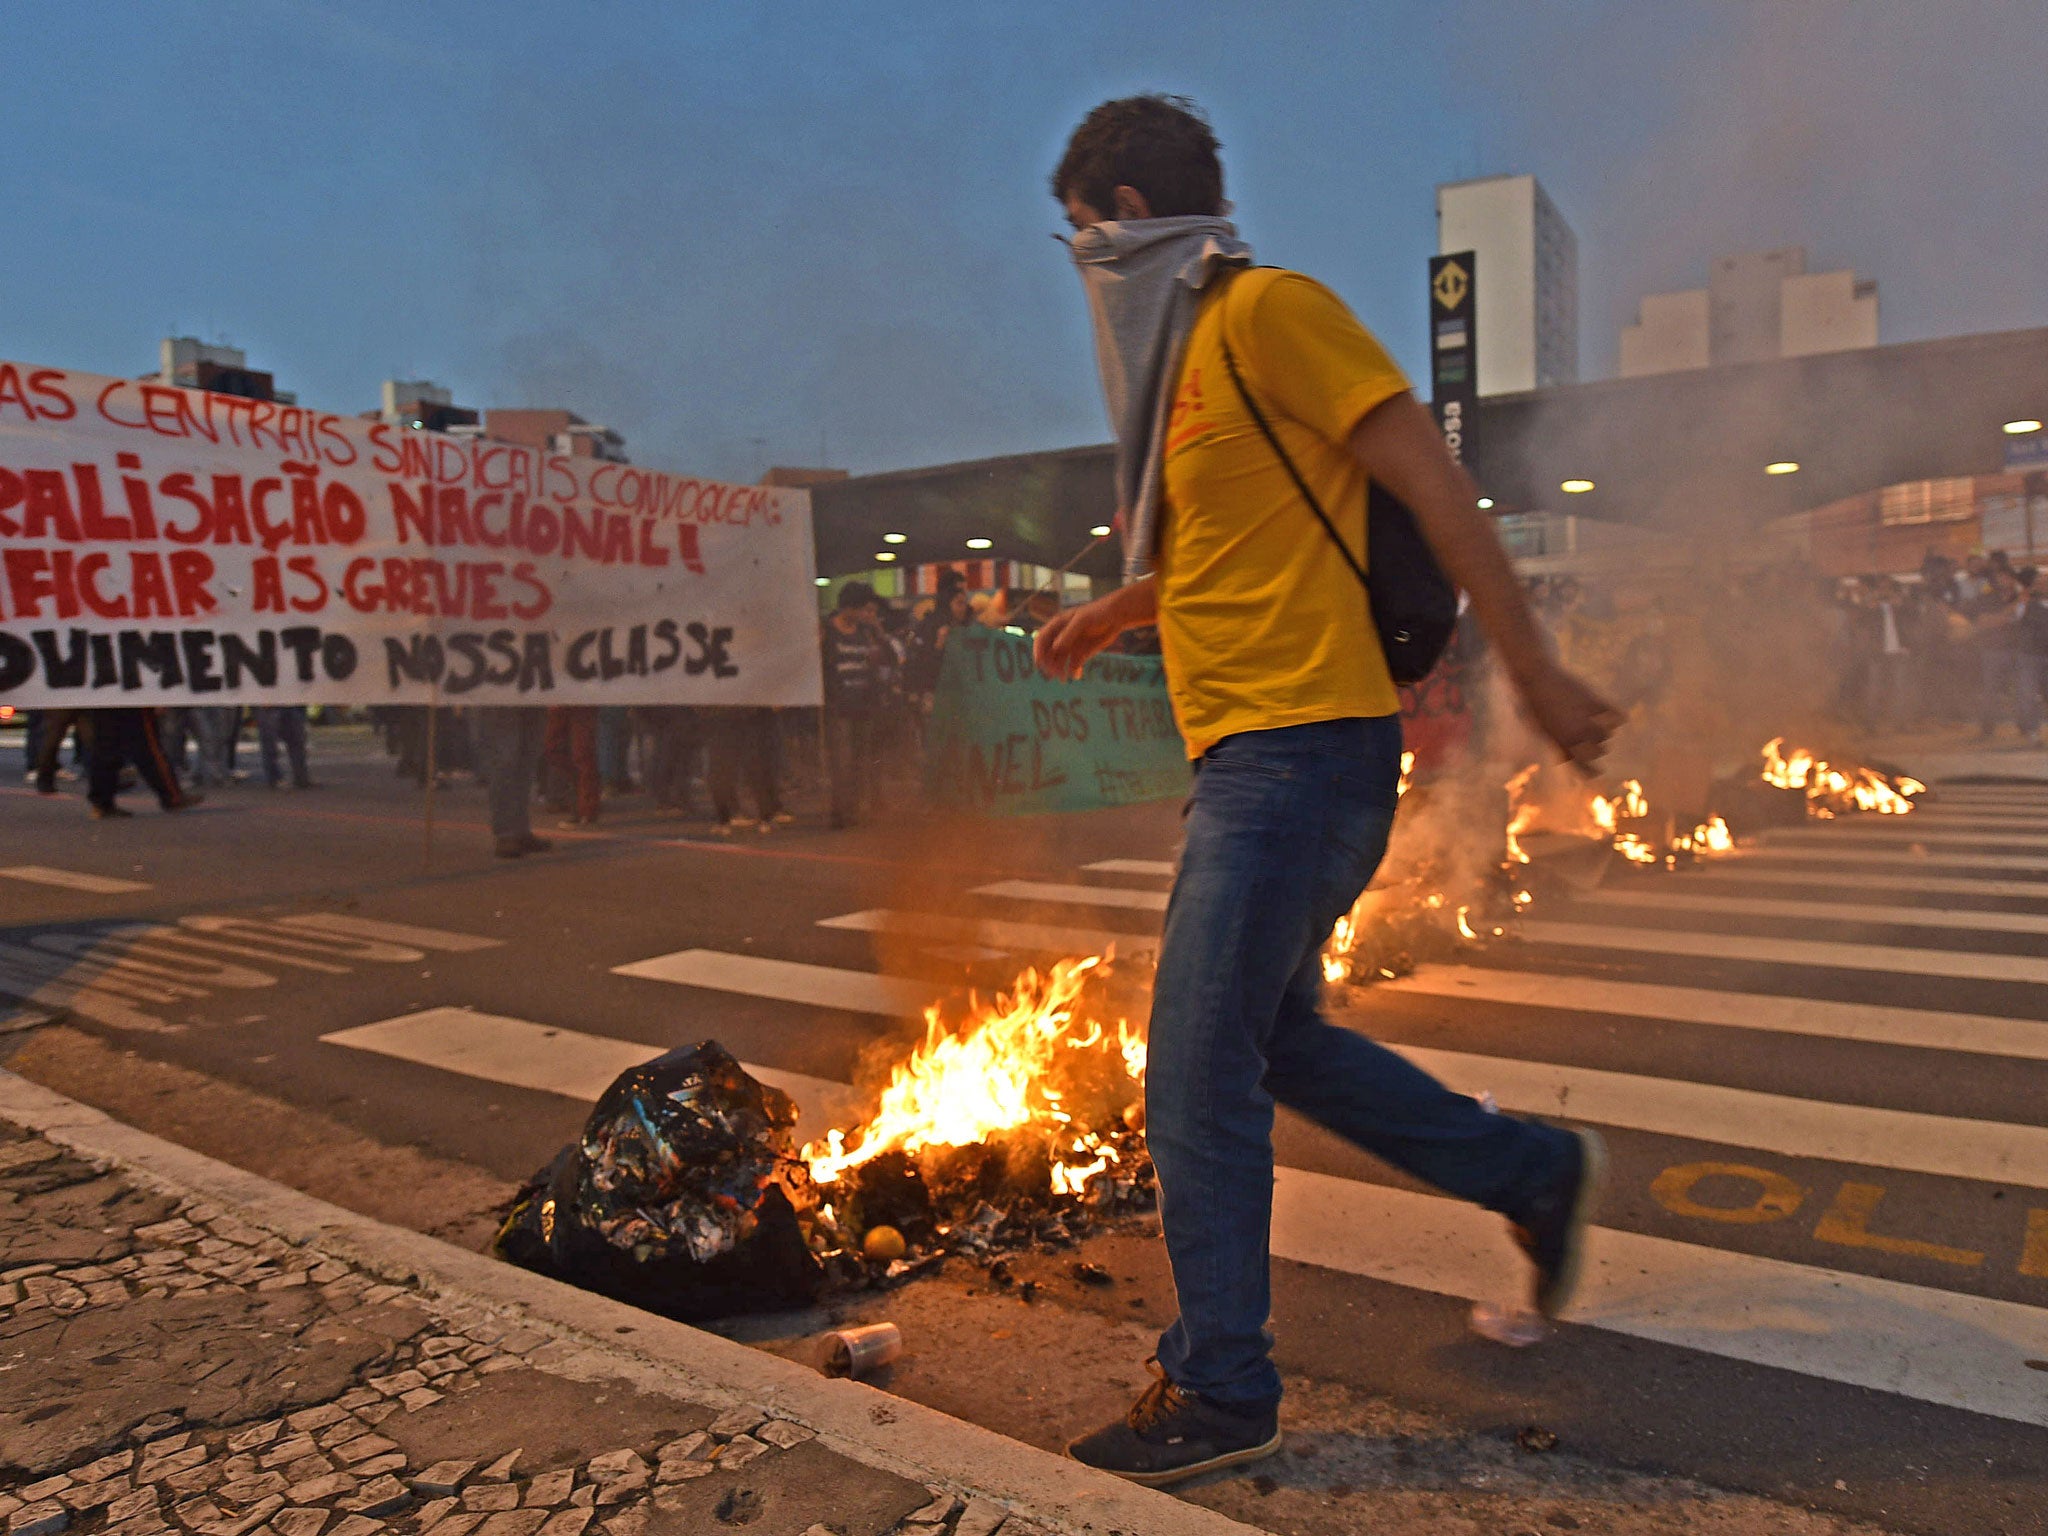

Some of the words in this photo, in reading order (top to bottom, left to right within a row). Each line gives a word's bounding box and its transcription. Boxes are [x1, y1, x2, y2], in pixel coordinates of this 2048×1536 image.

[97, 381, 358, 466] CENTRAIS
[0, 548, 218, 623] FICAR
[343, 556, 552, 622] GREVES
[383, 631, 554, 693] NOSSA
[566, 619, 739, 681] CLASSE
